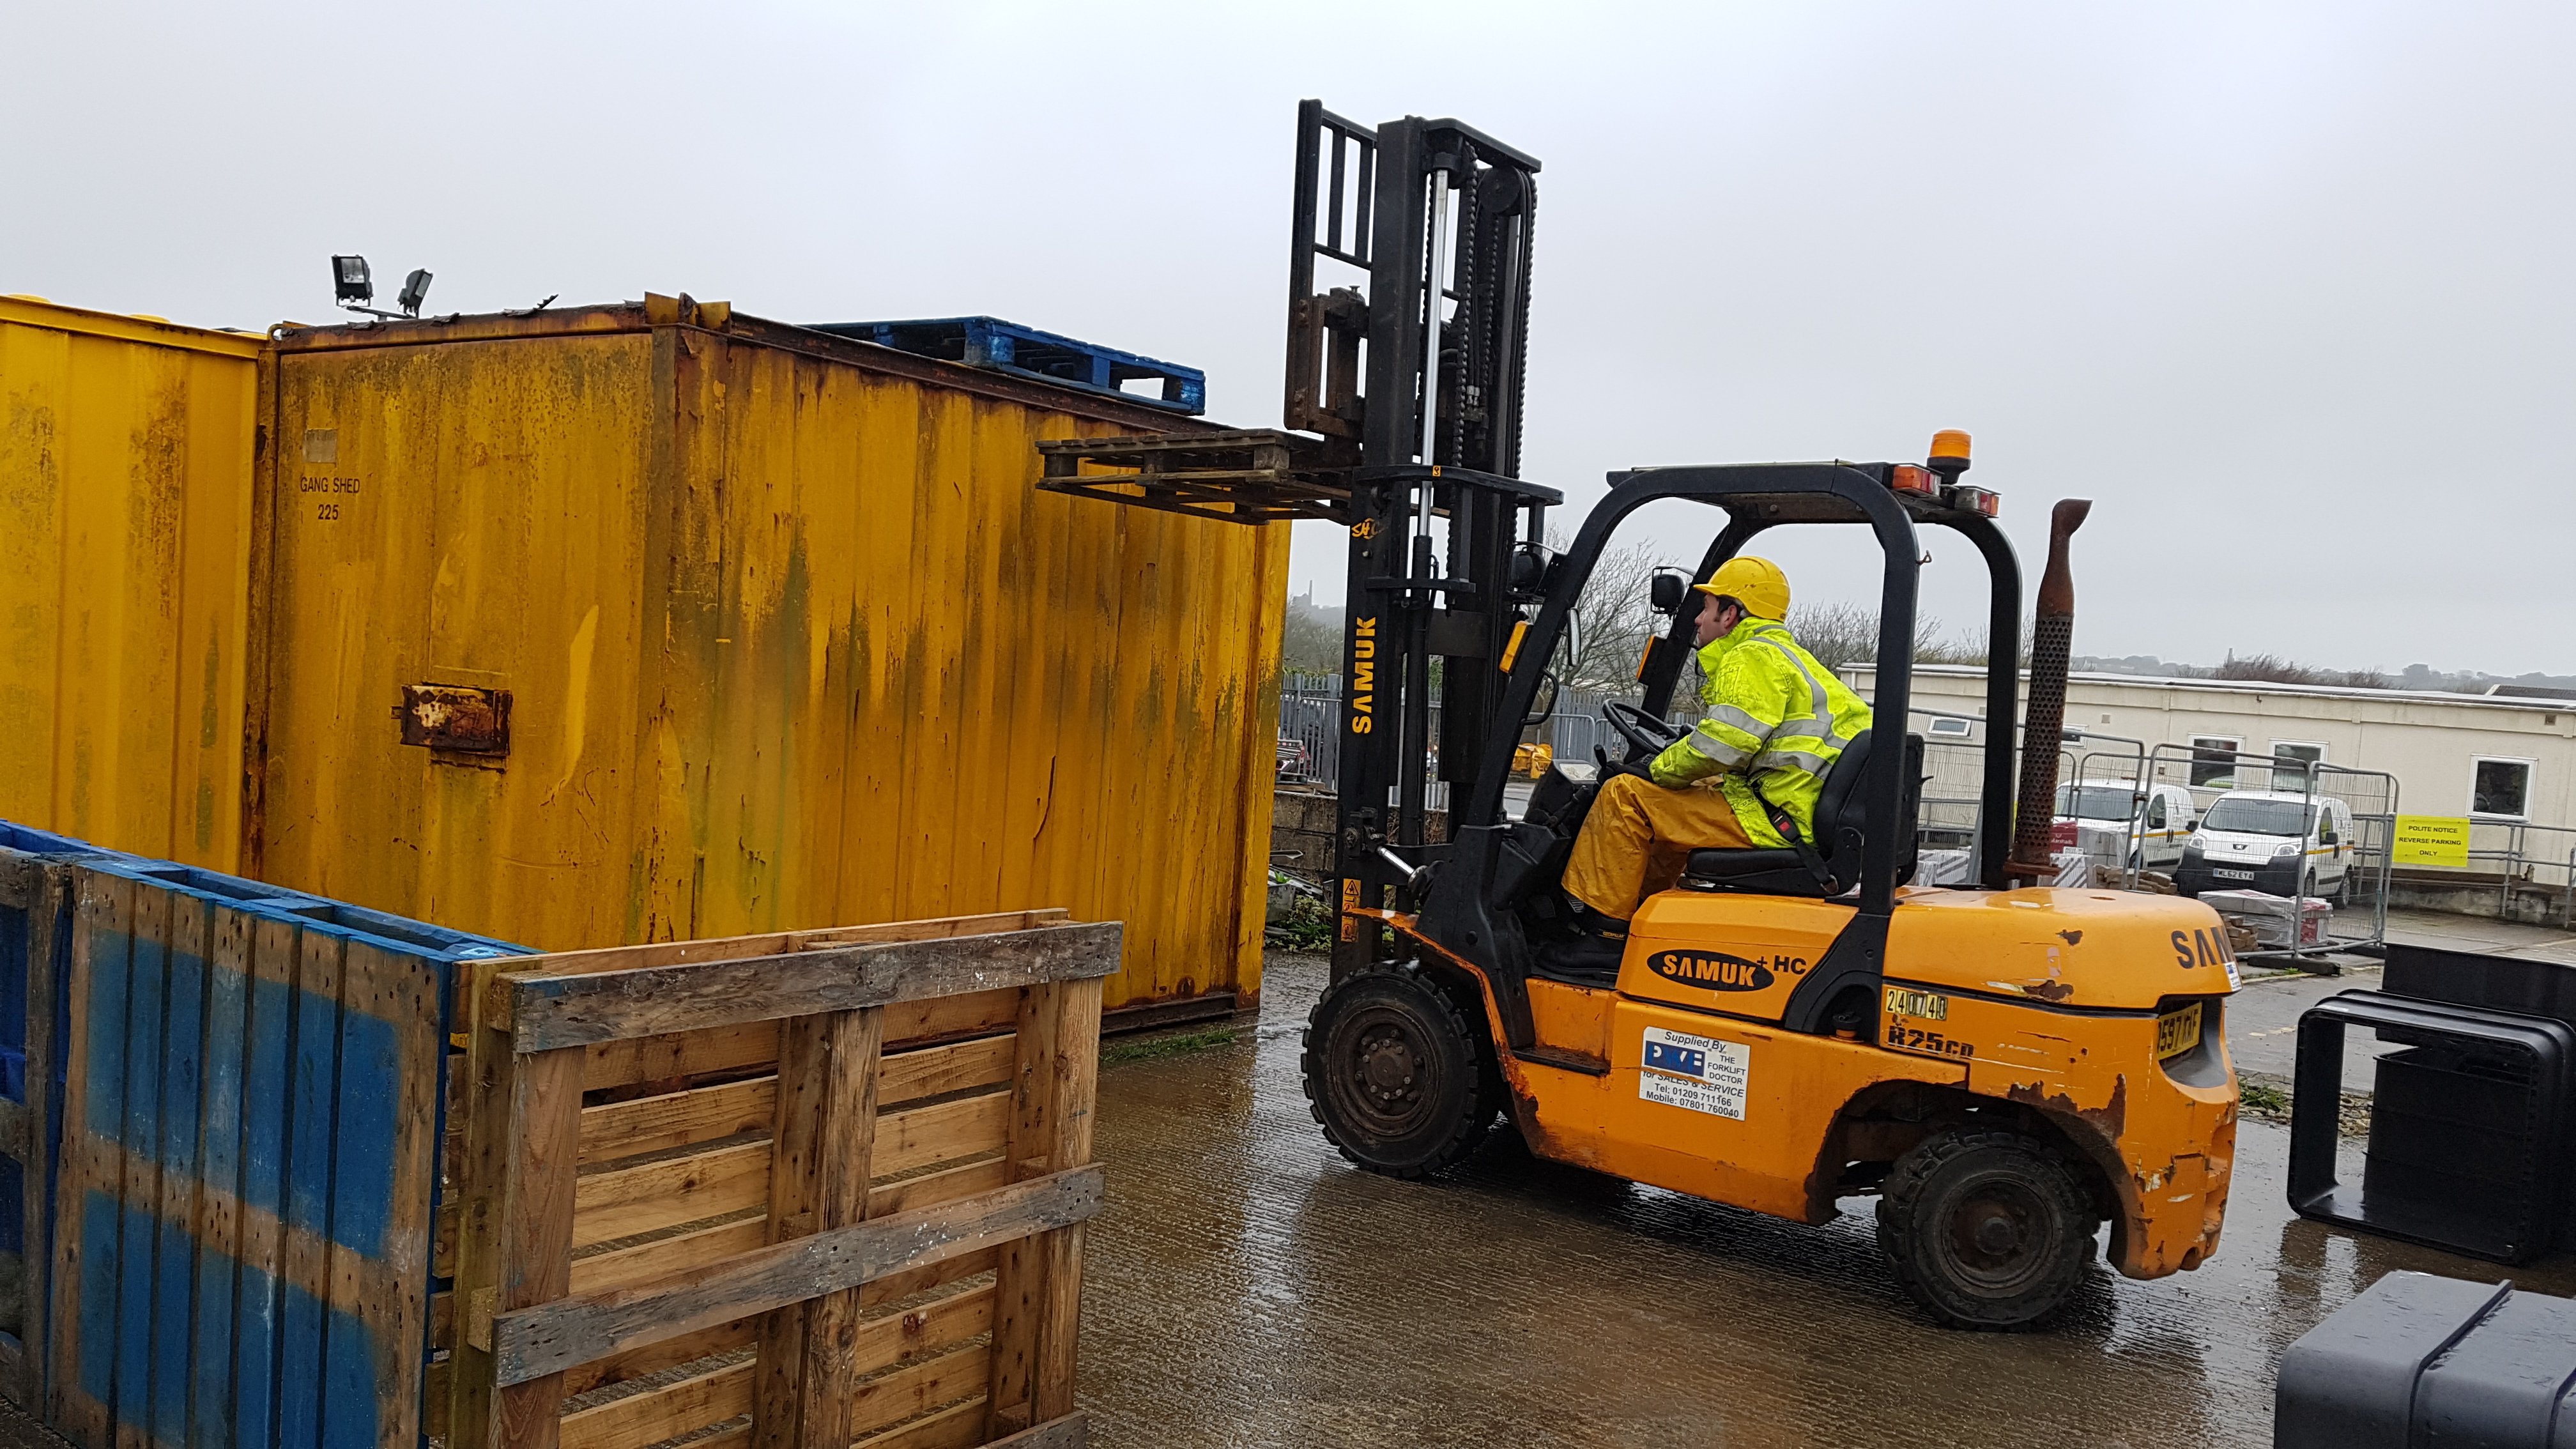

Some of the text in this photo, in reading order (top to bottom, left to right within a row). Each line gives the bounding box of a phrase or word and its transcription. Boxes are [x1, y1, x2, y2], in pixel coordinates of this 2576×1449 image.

[300, 477, 360, 493] GANG SHED
[318, 504, 339, 520] 225
[1352, 617, 1376, 734] SAMUK
[1662, 954, 1757, 987] SAMUK
[1887, 991, 1945, 1018] 240740
[1664, 1031, 1726, 1052] Supplied By
[1707, 1062, 1746, 1076] FORKLIFT
[1720, 1055, 1735, 1064] THE
[1657, 1074, 1689, 1086] SALES
[1701, 1083, 1745, 1098] SERVICE
[1709, 1072, 1743, 1085] DOCTOR
[1646, 1091, 1739, 1118] Mobile: 07801 760040
[1655, 1083, 1732, 1107] Tel: 01209 711166
